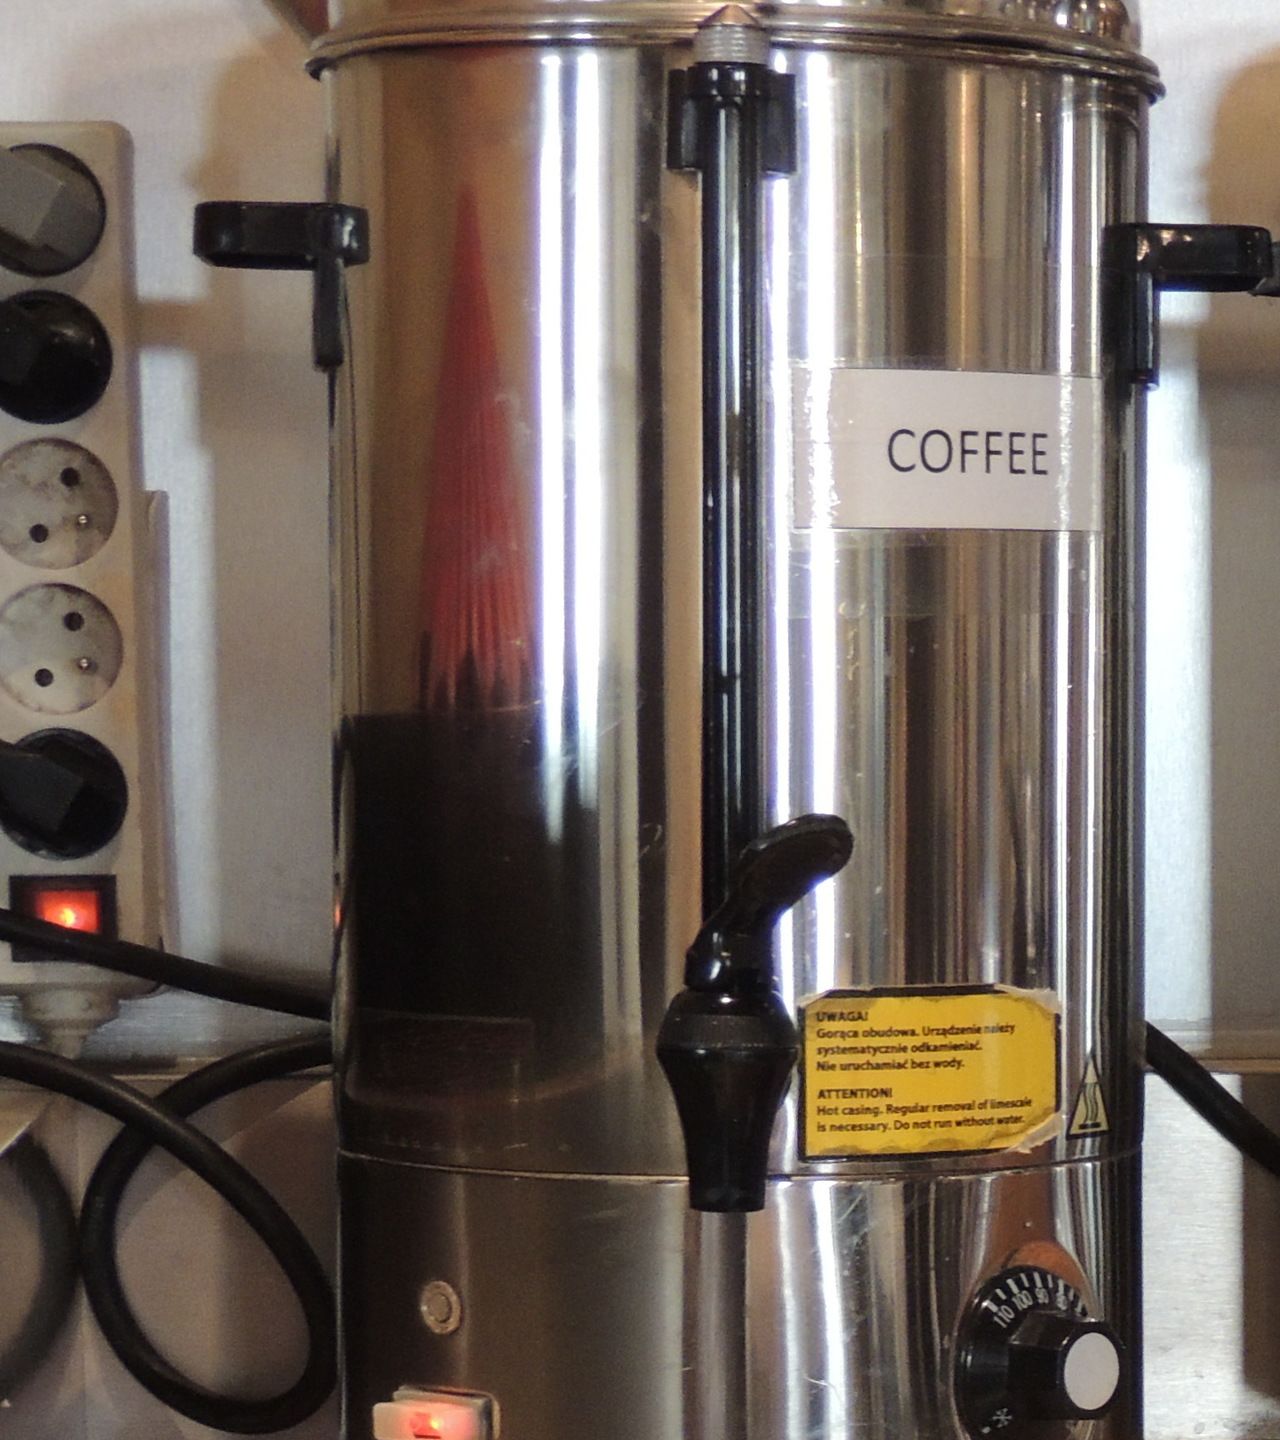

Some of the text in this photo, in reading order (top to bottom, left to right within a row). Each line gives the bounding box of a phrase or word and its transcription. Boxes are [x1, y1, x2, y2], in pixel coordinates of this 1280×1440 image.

[888, 428, 1048, 475] COFFEE
[816, 1011, 869, 1022] UWAGA!
[816, 1028, 859, 1041] Gorąca
[862, 1026, 920, 1038] obudowa.
[816, 1043, 909, 1058] systematycznie
[816, 1060, 836, 1072] Nie
[911, 1058, 930, 1069] bez
[933, 1057, 965, 1070] wody.
[817, 1087, 893, 1099] ATTENTION!
[816, 1105, 839, 1116] Hot
[842, 1105, 884, 1118] casing.
[886, 1102, 930, 1117] Regular
[932, 1099, 976, 1112] removal
[977, 1098, 988, 1110] of
[829, 1122, 892, 1133] necessary.
[894, 1119, 910, 1131] Do
[912, 1119, 932, 1130] not
[934, 1120, 953, 1129] run
[955, 1115, 995, 1128] without
[993, 1304, 1016, 1329] 110
